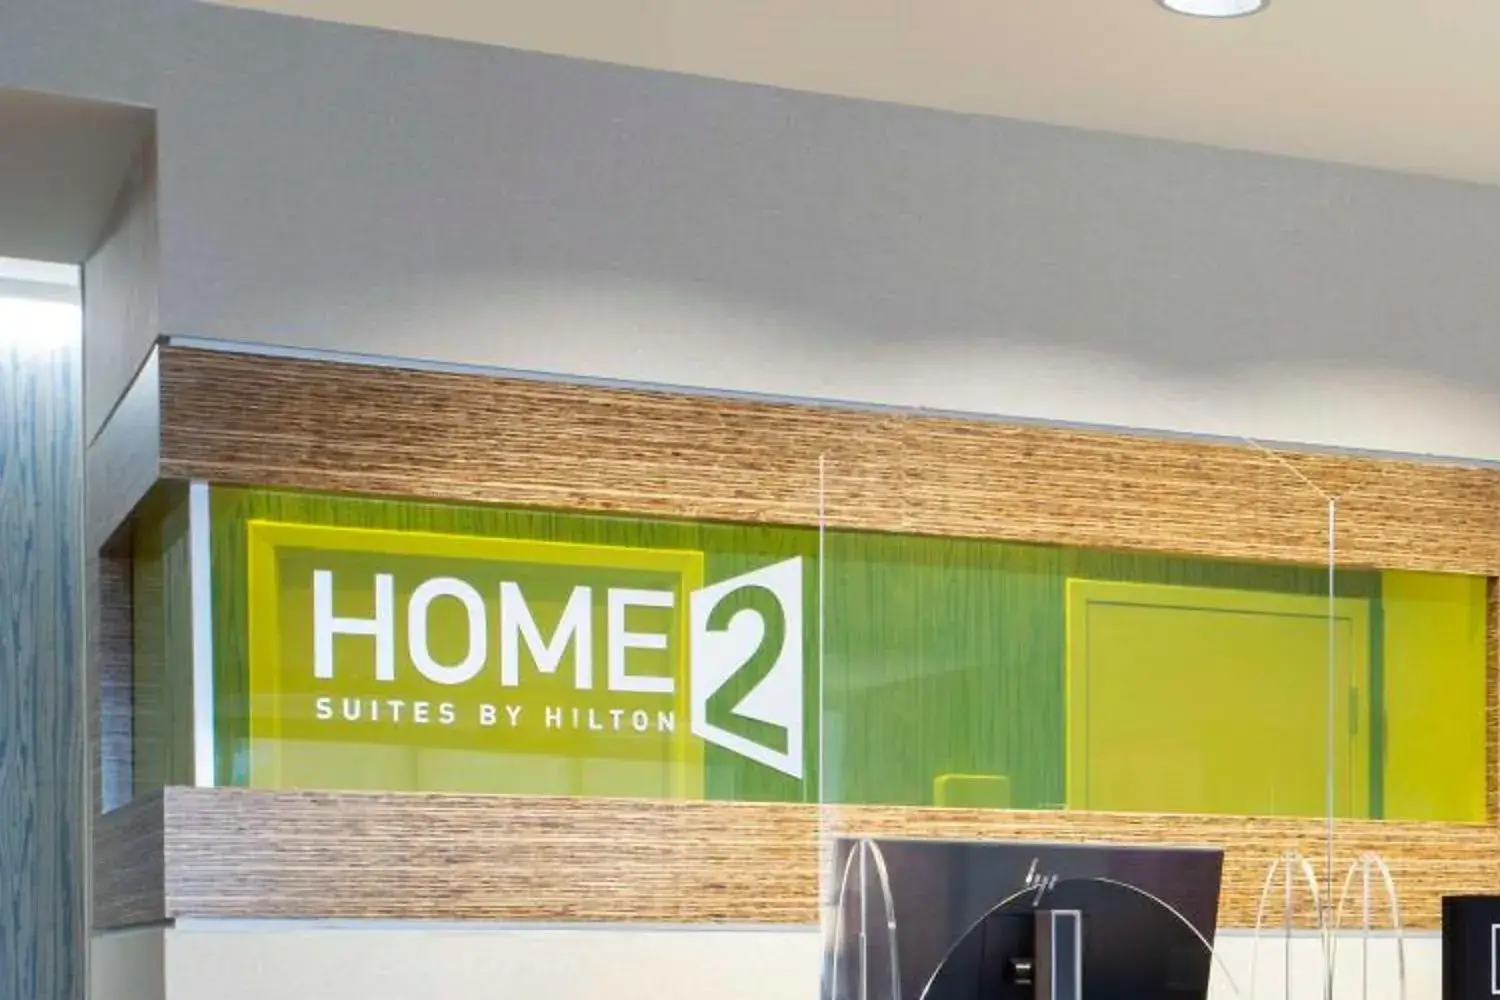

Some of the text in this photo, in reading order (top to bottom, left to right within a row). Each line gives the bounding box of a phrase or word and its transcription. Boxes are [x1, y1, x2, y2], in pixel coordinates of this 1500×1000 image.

[313, 569, 789, 757] HOME 2
[315, 697, 675, 733] SUITES BY HILTON
